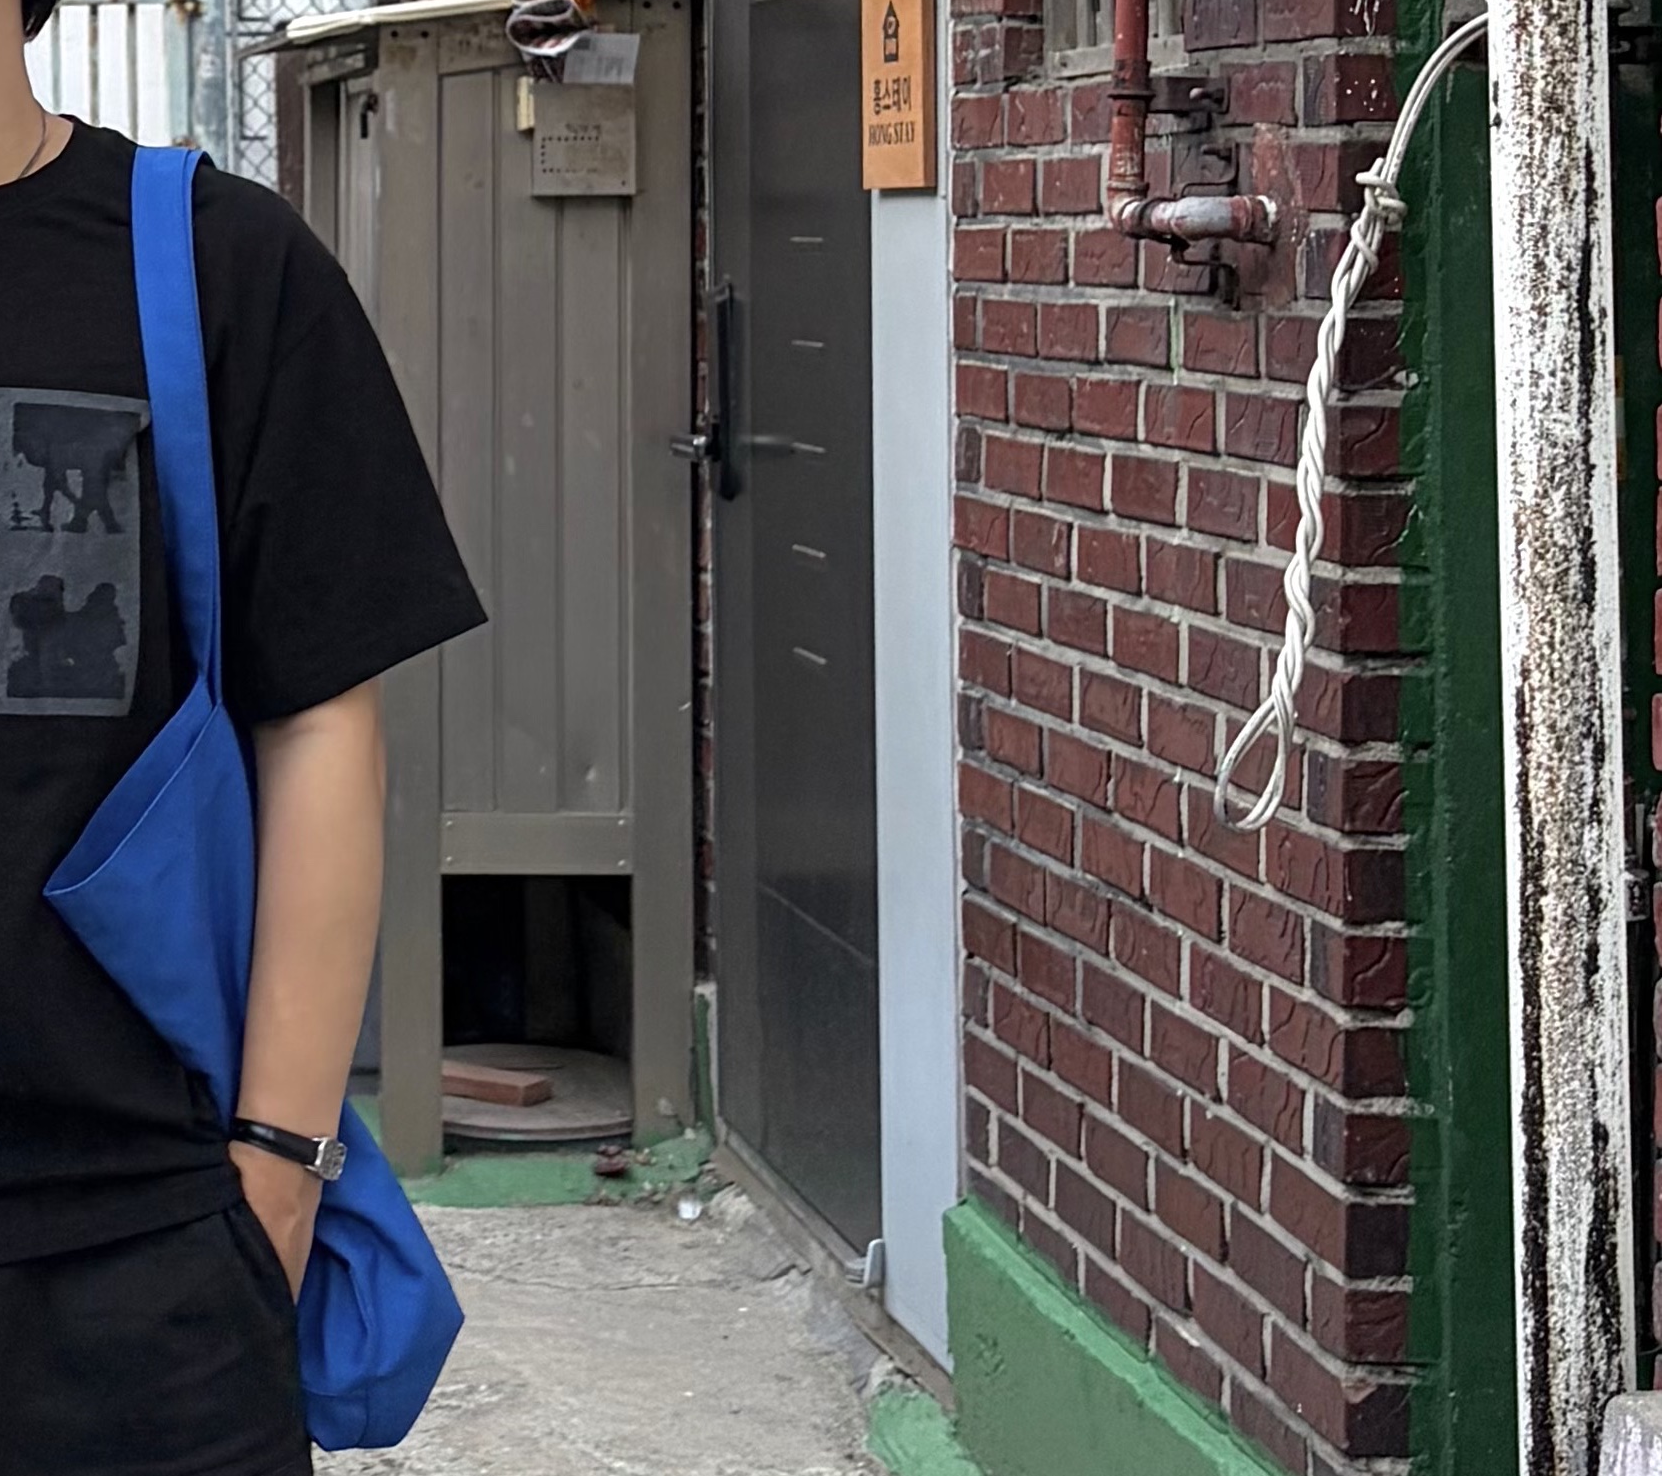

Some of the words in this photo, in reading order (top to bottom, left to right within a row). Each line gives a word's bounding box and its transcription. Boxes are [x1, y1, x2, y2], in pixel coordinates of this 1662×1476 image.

[873, 75, 912, 116] 홍스테이
[868, 123, 893, 146] HONG
[893, 121, 915, 144] STAY
